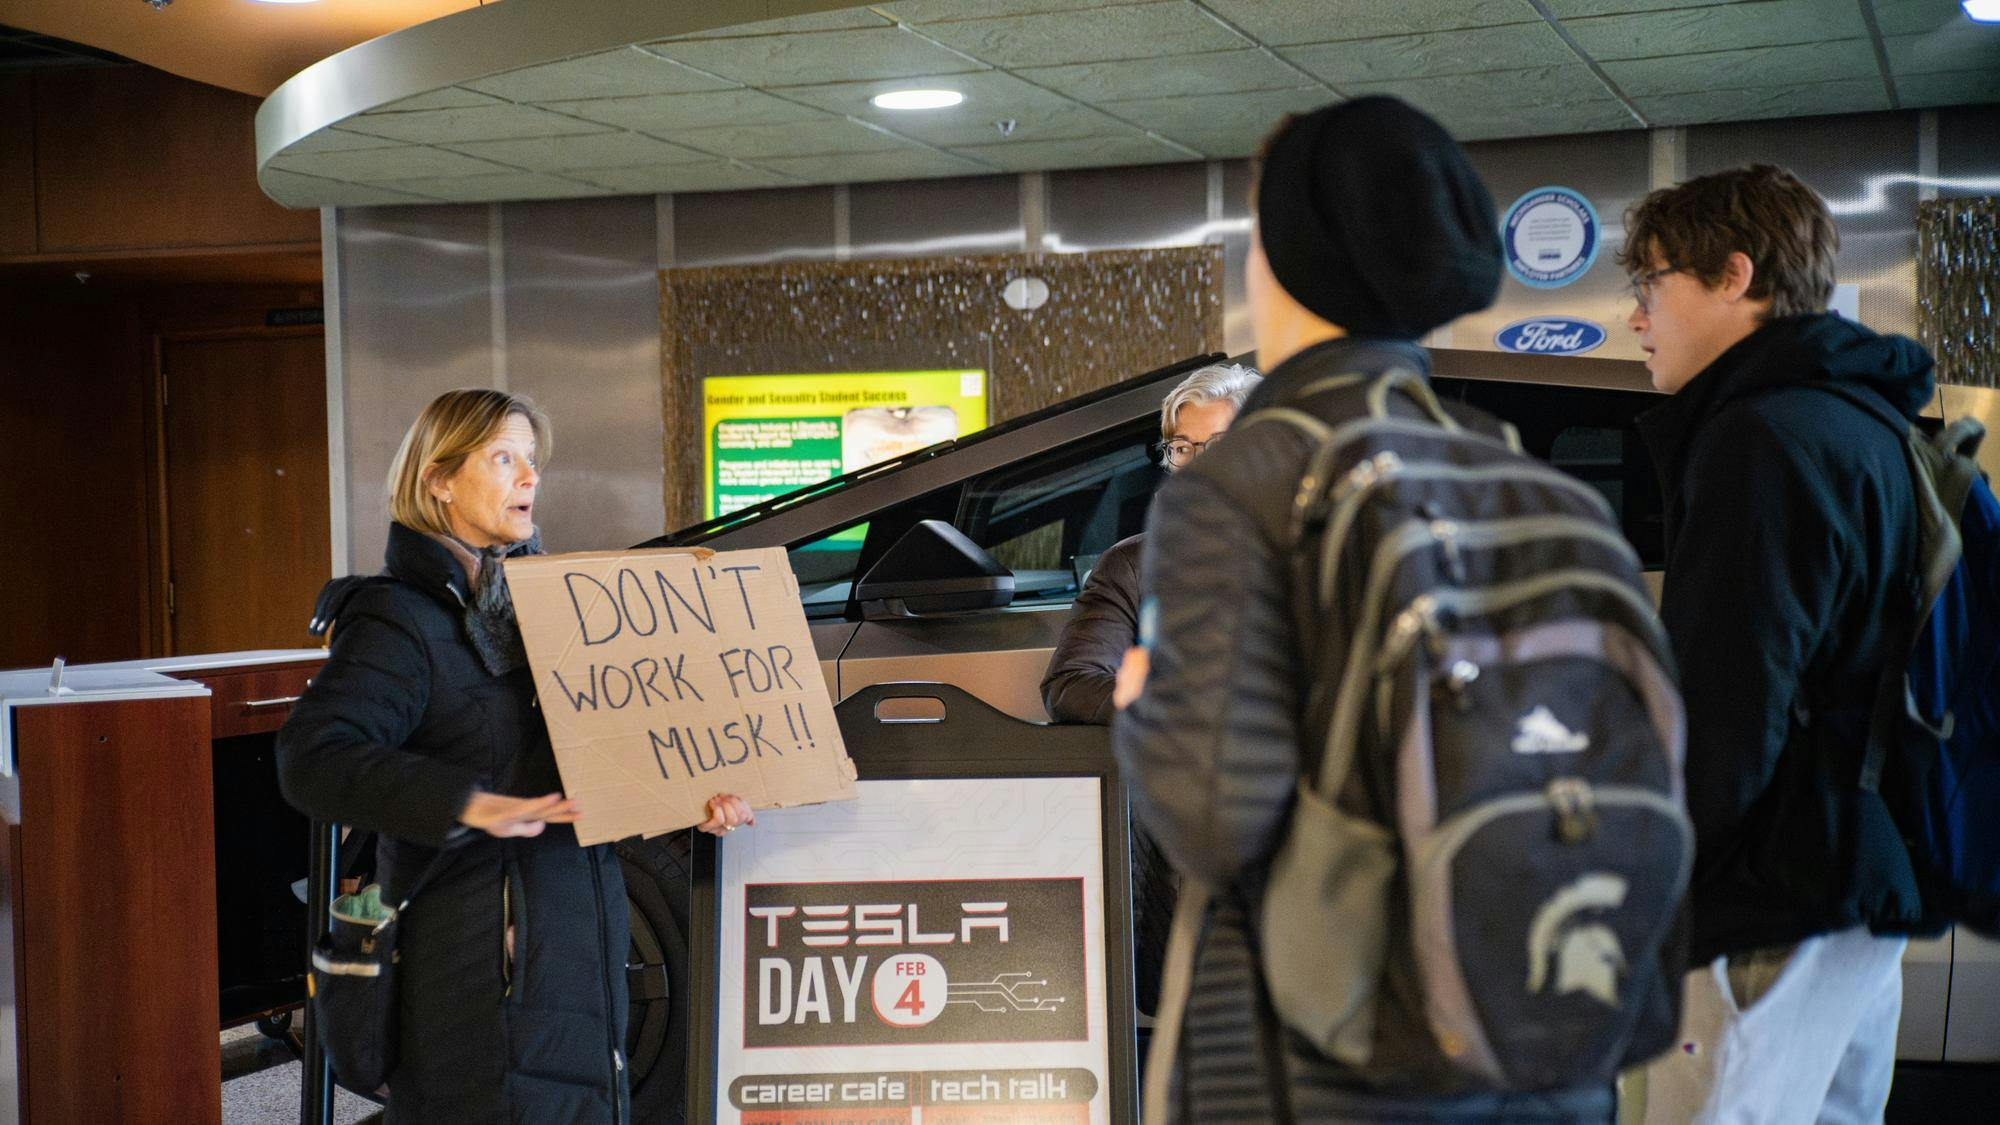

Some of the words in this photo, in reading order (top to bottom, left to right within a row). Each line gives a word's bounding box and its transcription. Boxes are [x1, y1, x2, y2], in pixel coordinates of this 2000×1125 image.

[1515, 322, 1584, 351] Ford
[707, 395, 743, 405] Gender
[748, 394, 765, 404] and
[769, 392, 816, 404] Sexuality
[820, 391, 859, 402] Student
[863, 390, 907, 401] Success
[564, 565, 761, 646] DON'T
[552, 653, 704, 712] WORK
[719, 645, 803, 698] FOR
[748, 902, 1009, 948] TESLA
[895, 961, 926, 976] FEB
[758, 955, 869, 1025] DAY
[893, 979, 925, 1016] 4
[741, 1082, 834, 1104] career
[841, 1076, 905, 1101] cafe
[931, 1074, 1000, 1102] tech
[1009, 1072, 1066, 1100] talk
